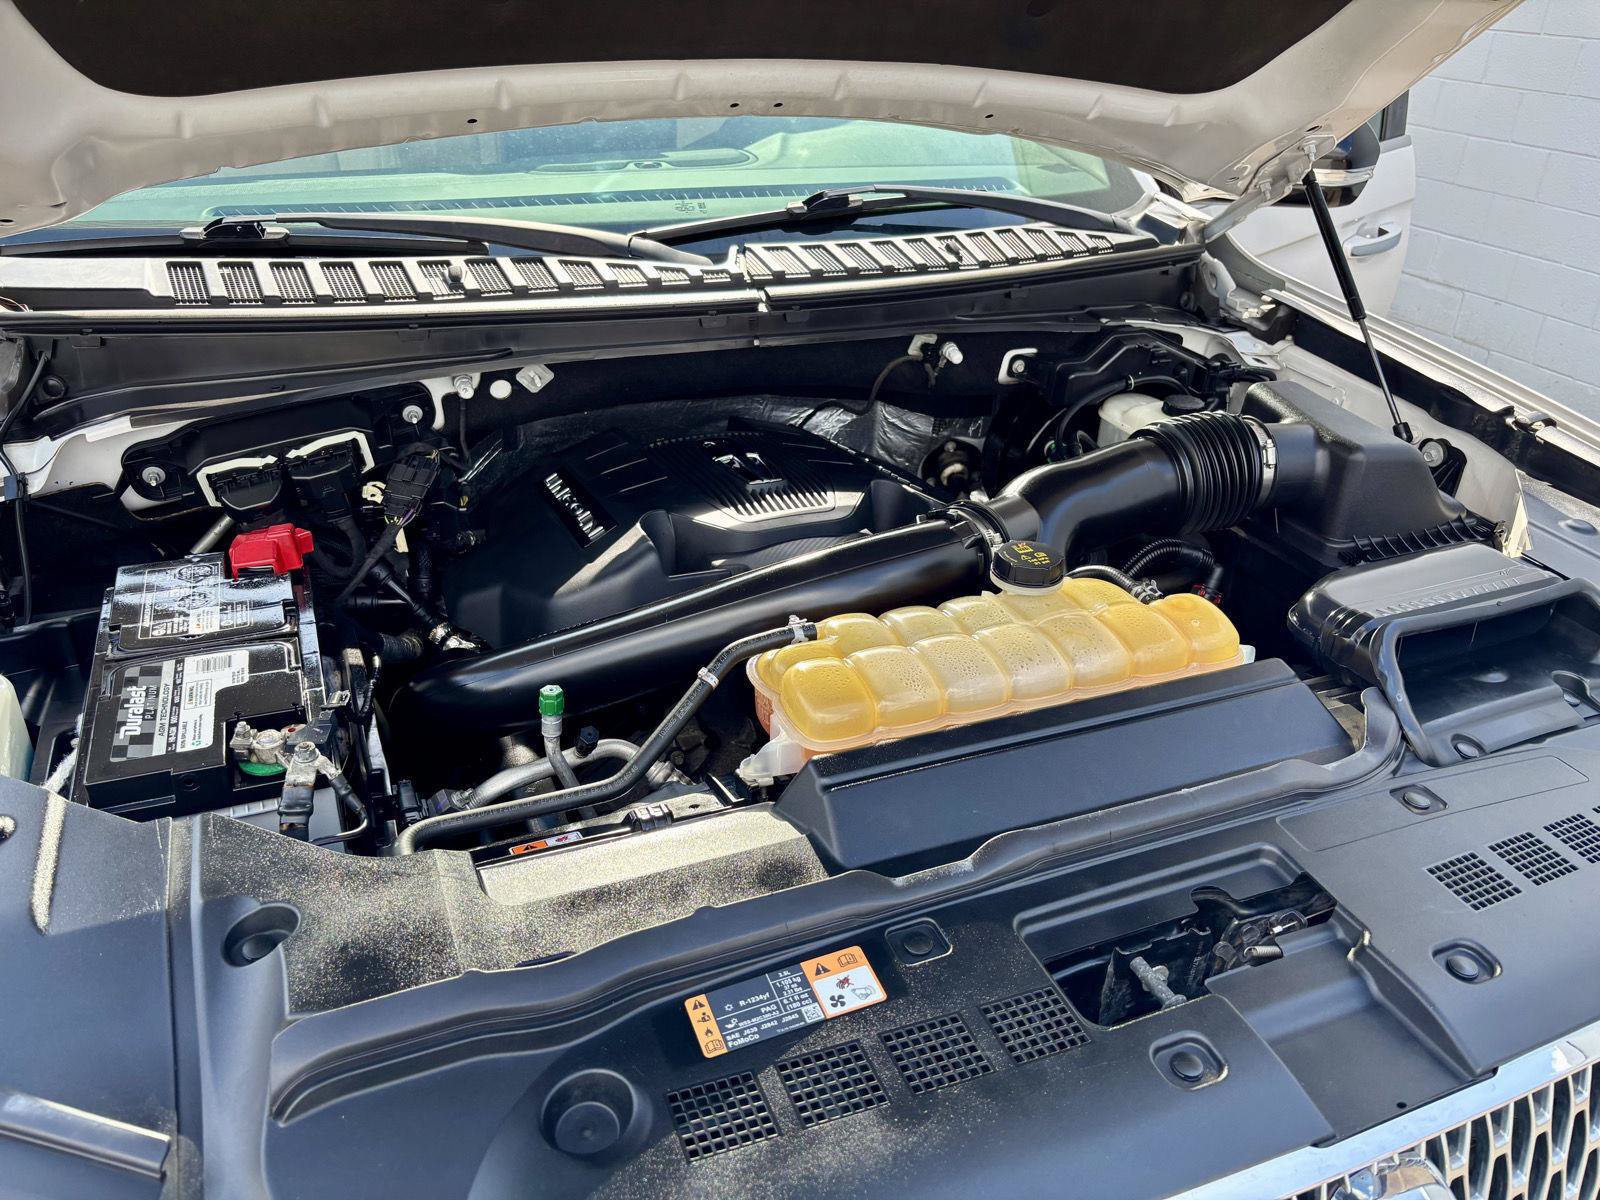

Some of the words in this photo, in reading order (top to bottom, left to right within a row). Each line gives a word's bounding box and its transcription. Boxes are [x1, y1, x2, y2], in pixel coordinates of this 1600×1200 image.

[544, 472, 605, 540] LINCOLN
[144, 685, 158, 720] PLATINUM
[160, 684, 171, 721] TECHNOLOGY
[119, 685, 147, 739] Duralast
[158, 722, 166, 737] AGM
[739, 991, 770, 1007] R-1234yf
[760, 1004, 777, 1014] PAG
[726, 1032, 741, 1041] SAE
[727, 1034, 760, 1048] FoMoCo
